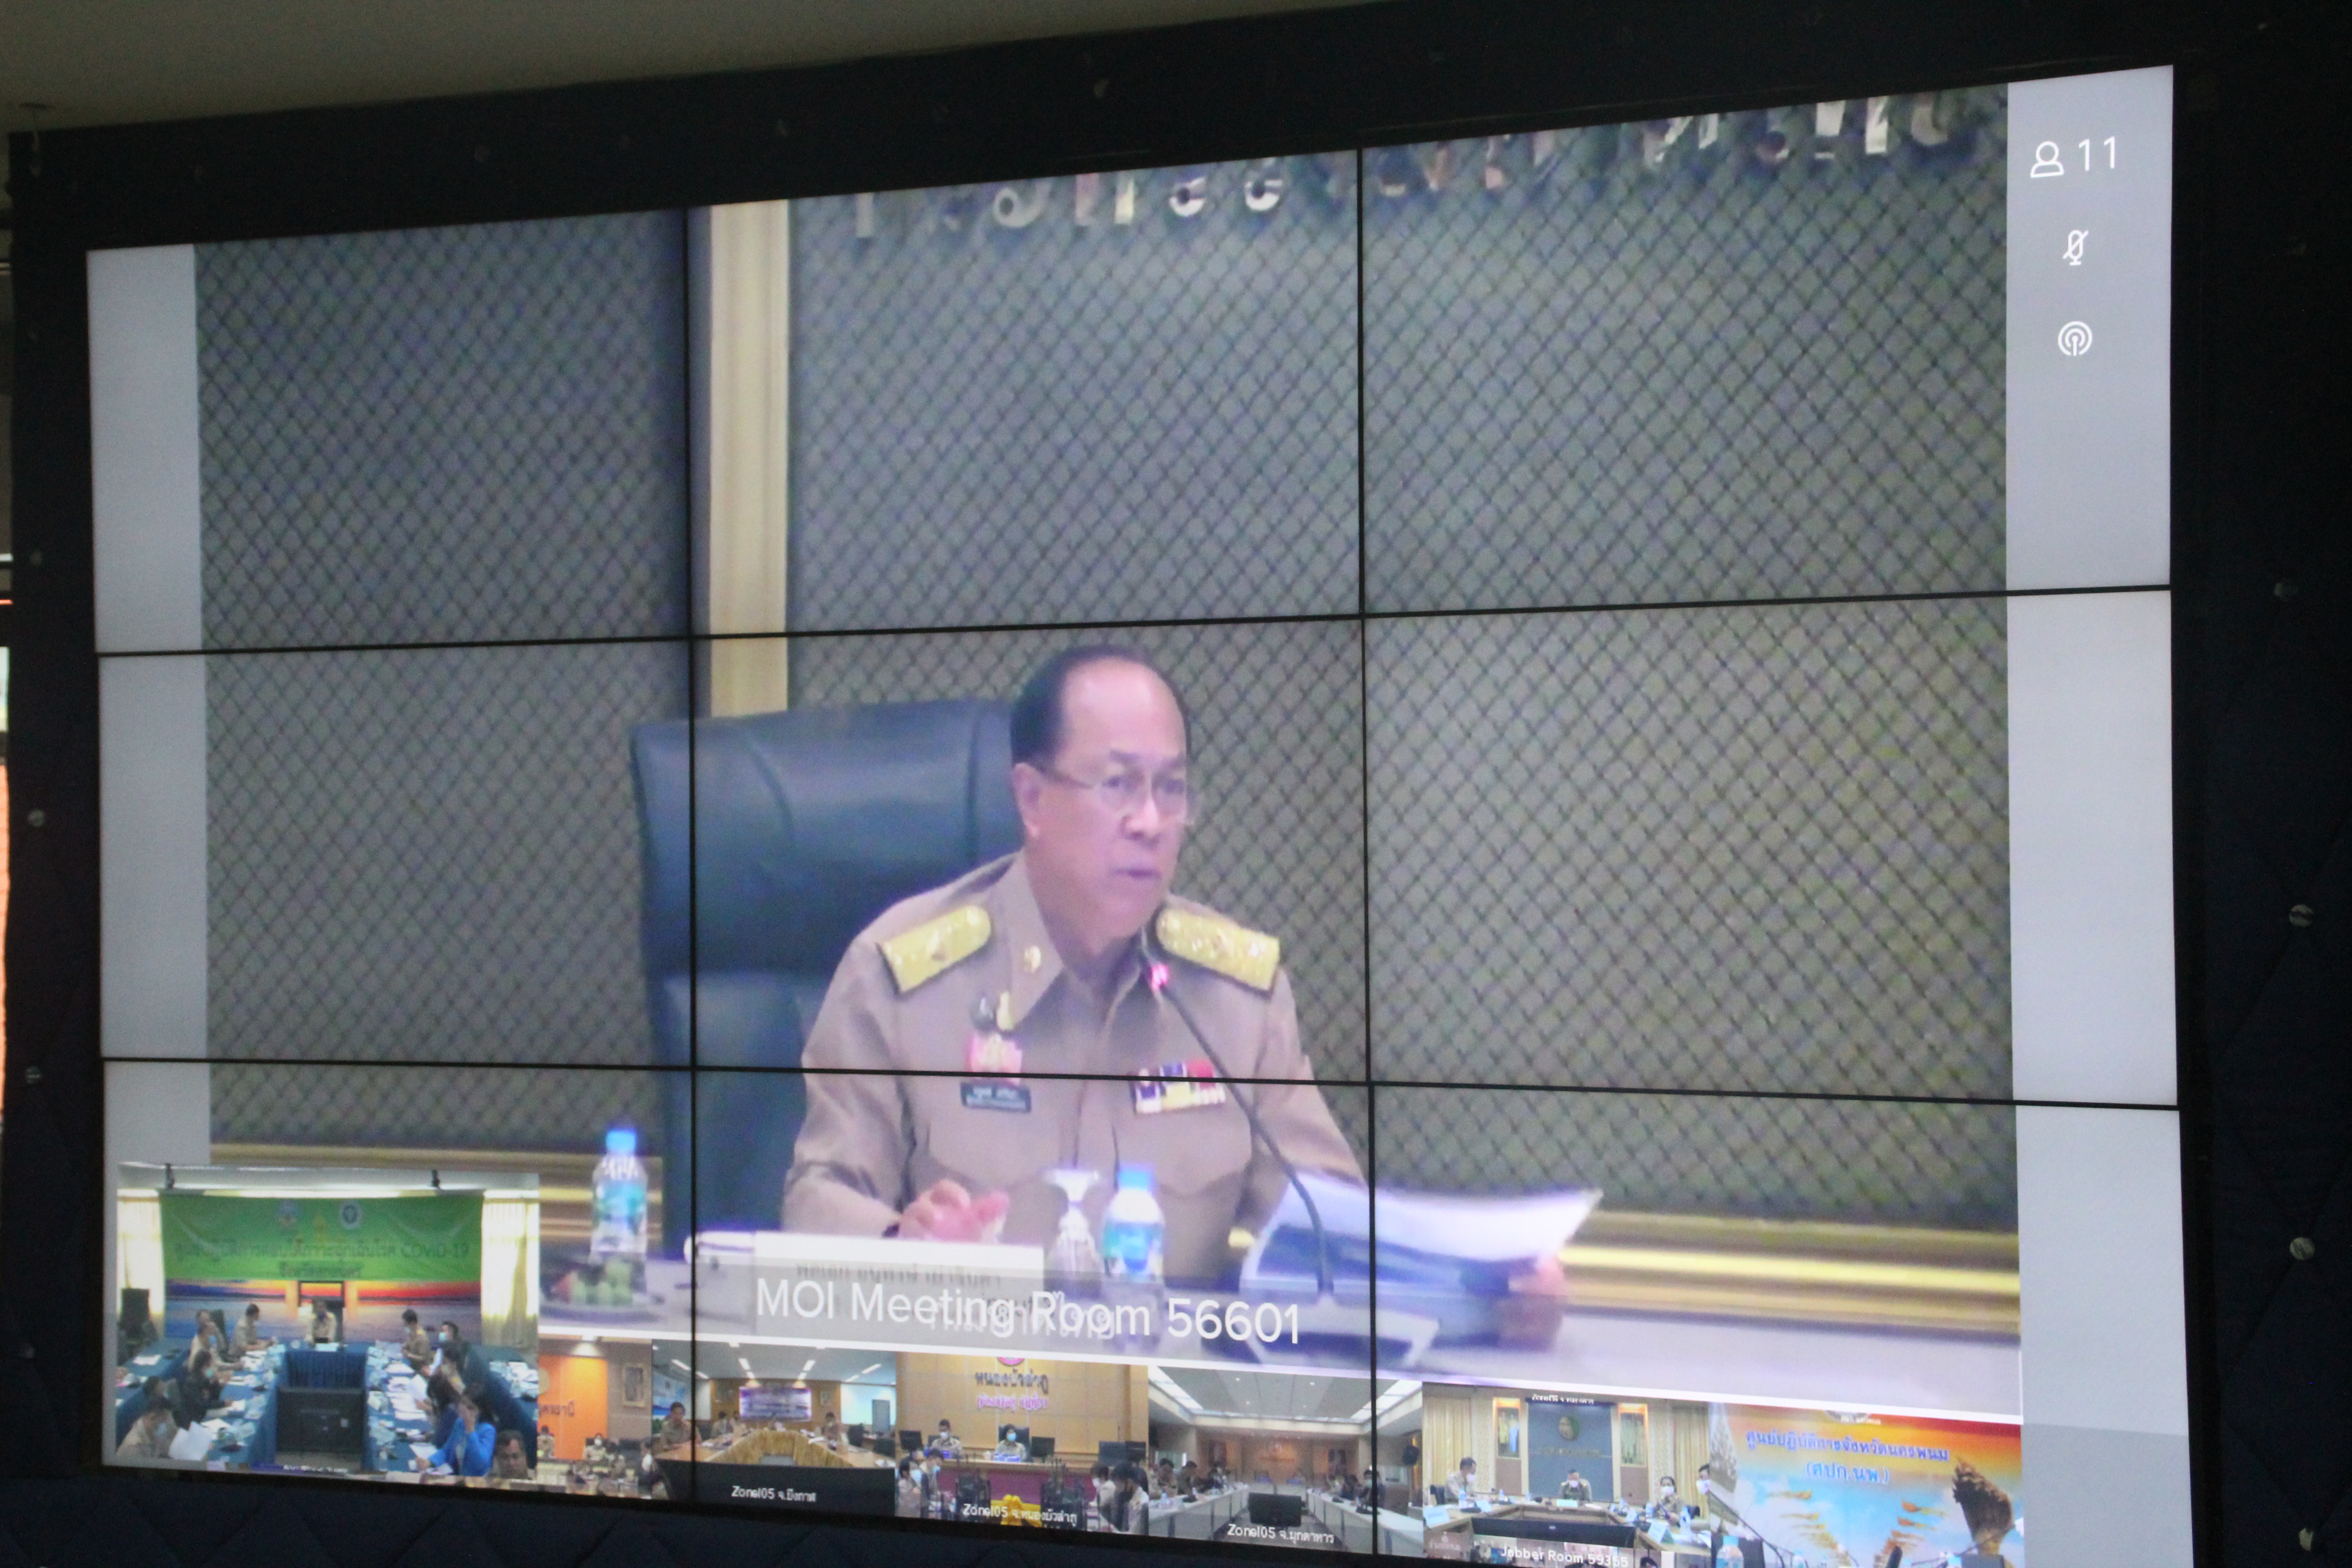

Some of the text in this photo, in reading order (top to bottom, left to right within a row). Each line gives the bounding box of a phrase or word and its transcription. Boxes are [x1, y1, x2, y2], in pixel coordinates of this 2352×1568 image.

[2078, 136, 2115, 171] 11
[757, 1278, 834, 1319] MOI
[851, 1282, 1014, 1338] Meeting
[1032, 1291, 1151, 1336] Room
[1167, 1298, 1298, 1344] 56601
[1501, 1545, 1544, 1562] Jabber
[1548, 1549, 1584, 1563] Room
